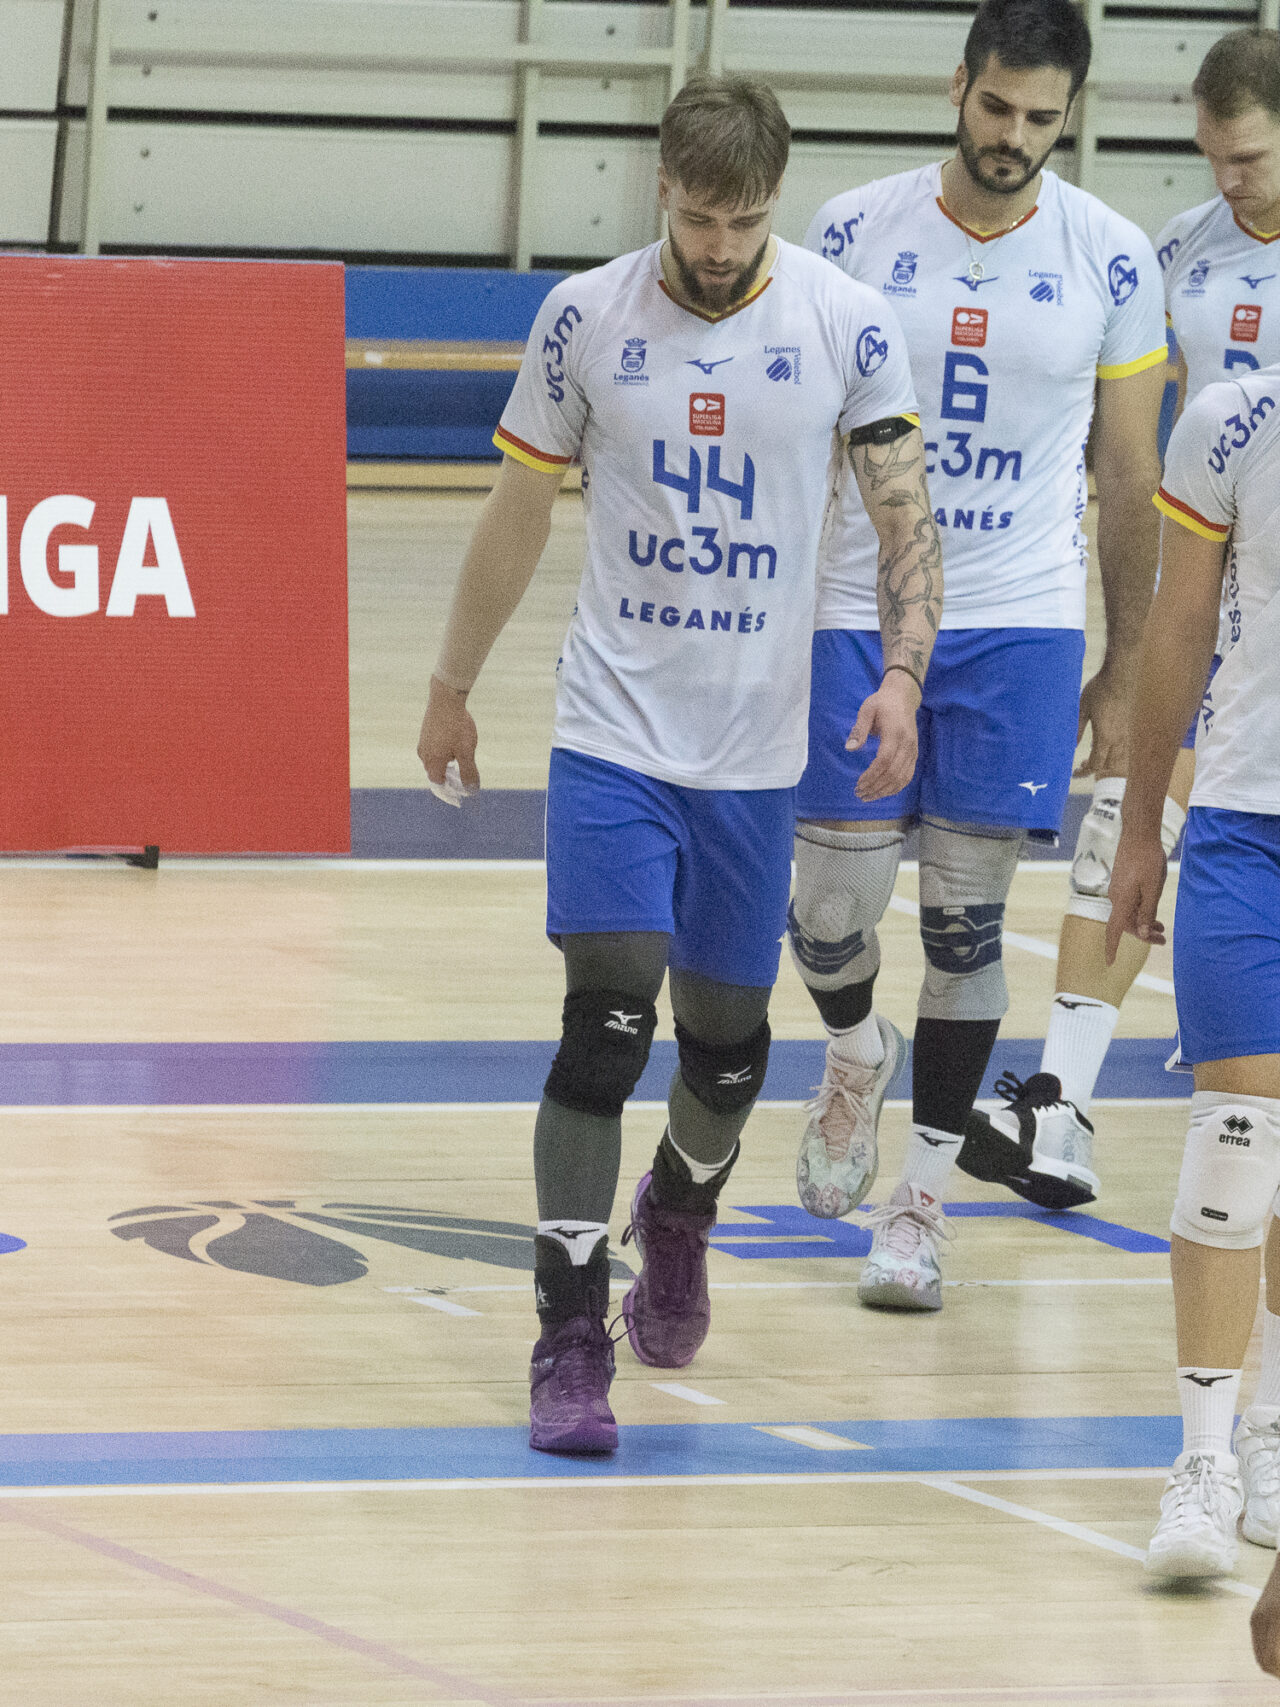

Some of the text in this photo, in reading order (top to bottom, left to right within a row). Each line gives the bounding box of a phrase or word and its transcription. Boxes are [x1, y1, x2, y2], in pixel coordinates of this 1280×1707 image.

[542, 304, 583, 403] uc3m
[763, 345, 802, 356] Leganes
[612, 372, 650, 383] Leganés
[939, 350, 990, 423] 6
[923, 430, 1023, 482] c3m
[1207, 395, 1277, 475] uc3m
[652, 439, 756, 520] 44
[933, 505, 1014, 531] ANÉS
[627, 526, 778, 580] uc3m
[619, 598, 768, 634] LEGANÉS
[1218, 1132, 1251, 1148] errea
